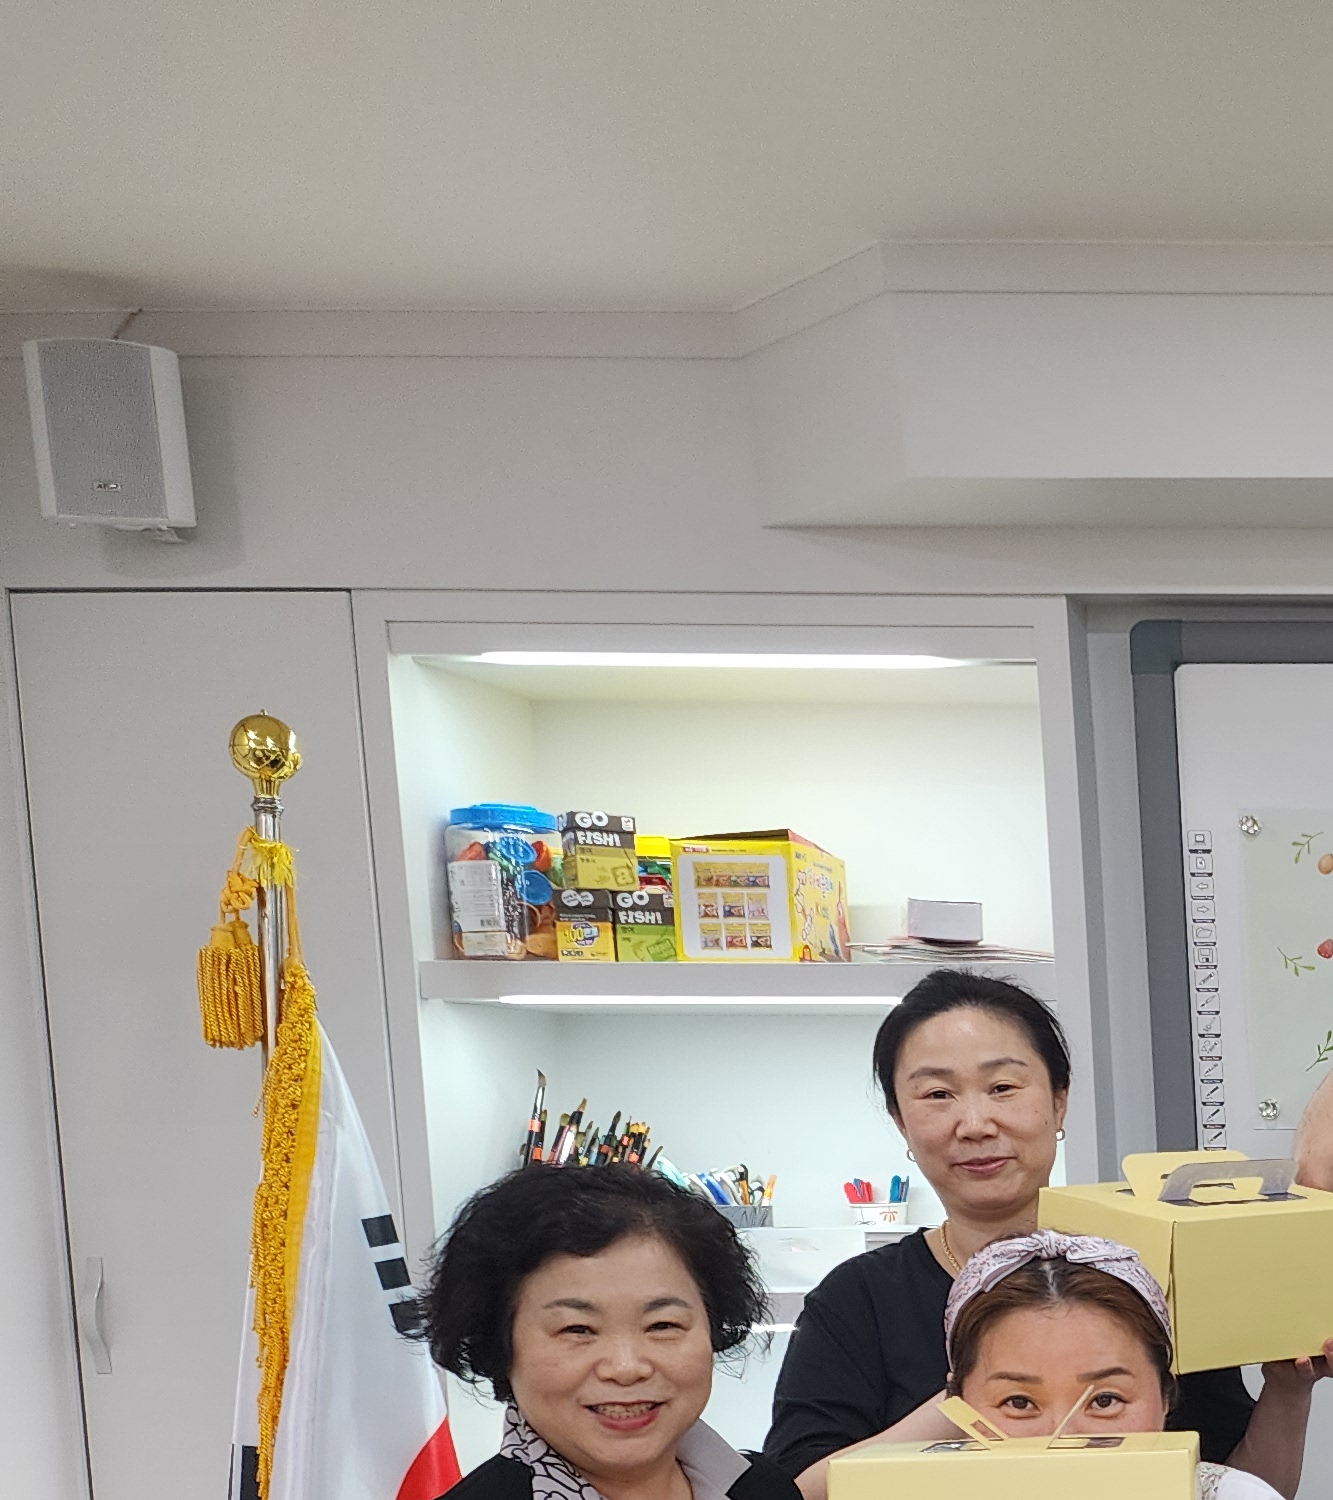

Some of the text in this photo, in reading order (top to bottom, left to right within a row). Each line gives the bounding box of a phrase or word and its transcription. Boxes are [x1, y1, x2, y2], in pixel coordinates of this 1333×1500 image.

[575, 811, 609, 828] GO
[576, 831, 622, 847] FISH!
[616, 890, 650, 908] GO
[618, 910, 662, 924] FISH!
